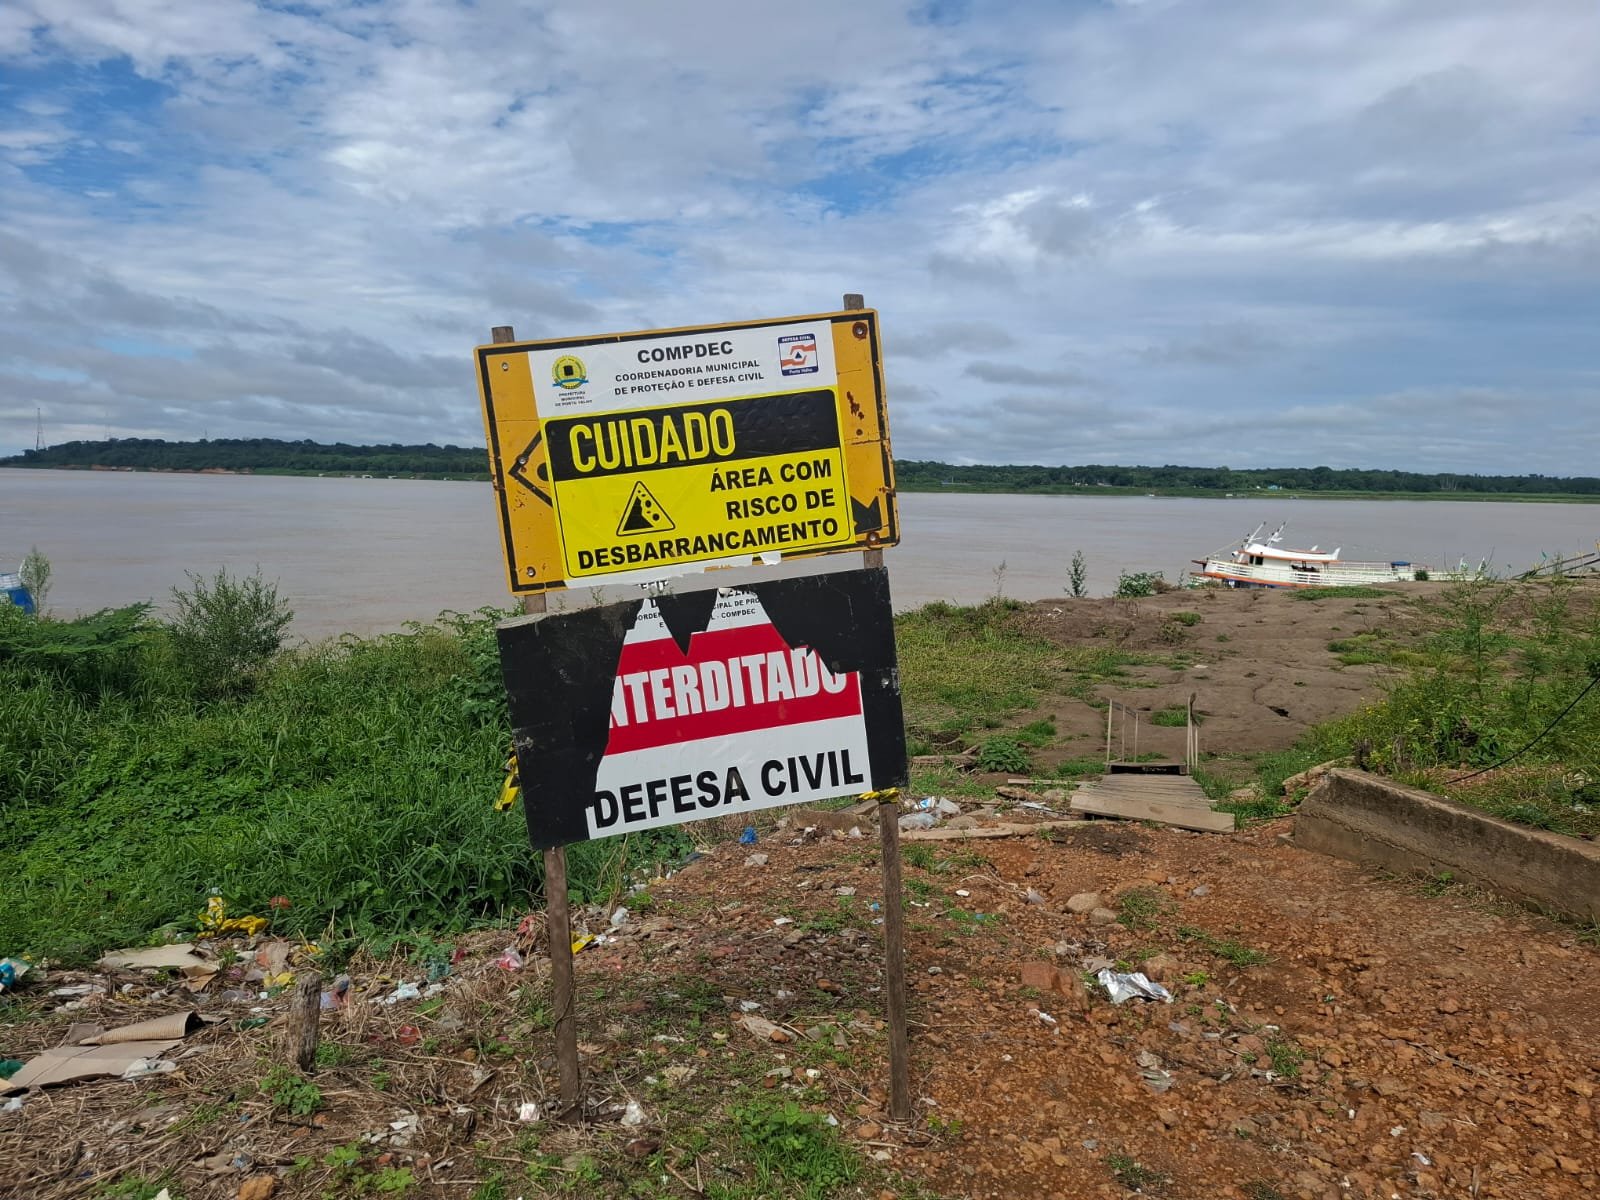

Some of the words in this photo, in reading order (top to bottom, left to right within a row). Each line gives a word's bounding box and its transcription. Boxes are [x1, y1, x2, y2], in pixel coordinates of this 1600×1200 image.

[637, 340, 733, 363] COMPDEC
[614, 387, 628, 395] DE
[631, 380, 685, 393] PROTEÇÃO
[688, 379, 694, 387] E
[697, 375, 735, 386] DEFESA
[737, 372, 764, 382] CIVIL
[615, 366, 703, 382] COORDENADORIA
[705, 359, 760, 373] MUNICIPAL
[569, 408, 736, 473] CUIDADO
[710, 467, 773, 492] ÁREA
[779, 458, 832, 481] COM
[725, 493, 798, 520] RISCO
[805, 488, 835, 510] DE
[577, 518, 839, 569] DESBARRANCAMENTO
[721, 608, 756, 618] COMPDEC
[593, 766, 750, 829] DEFESA
[760, 749, 865, 797] CIVIL
